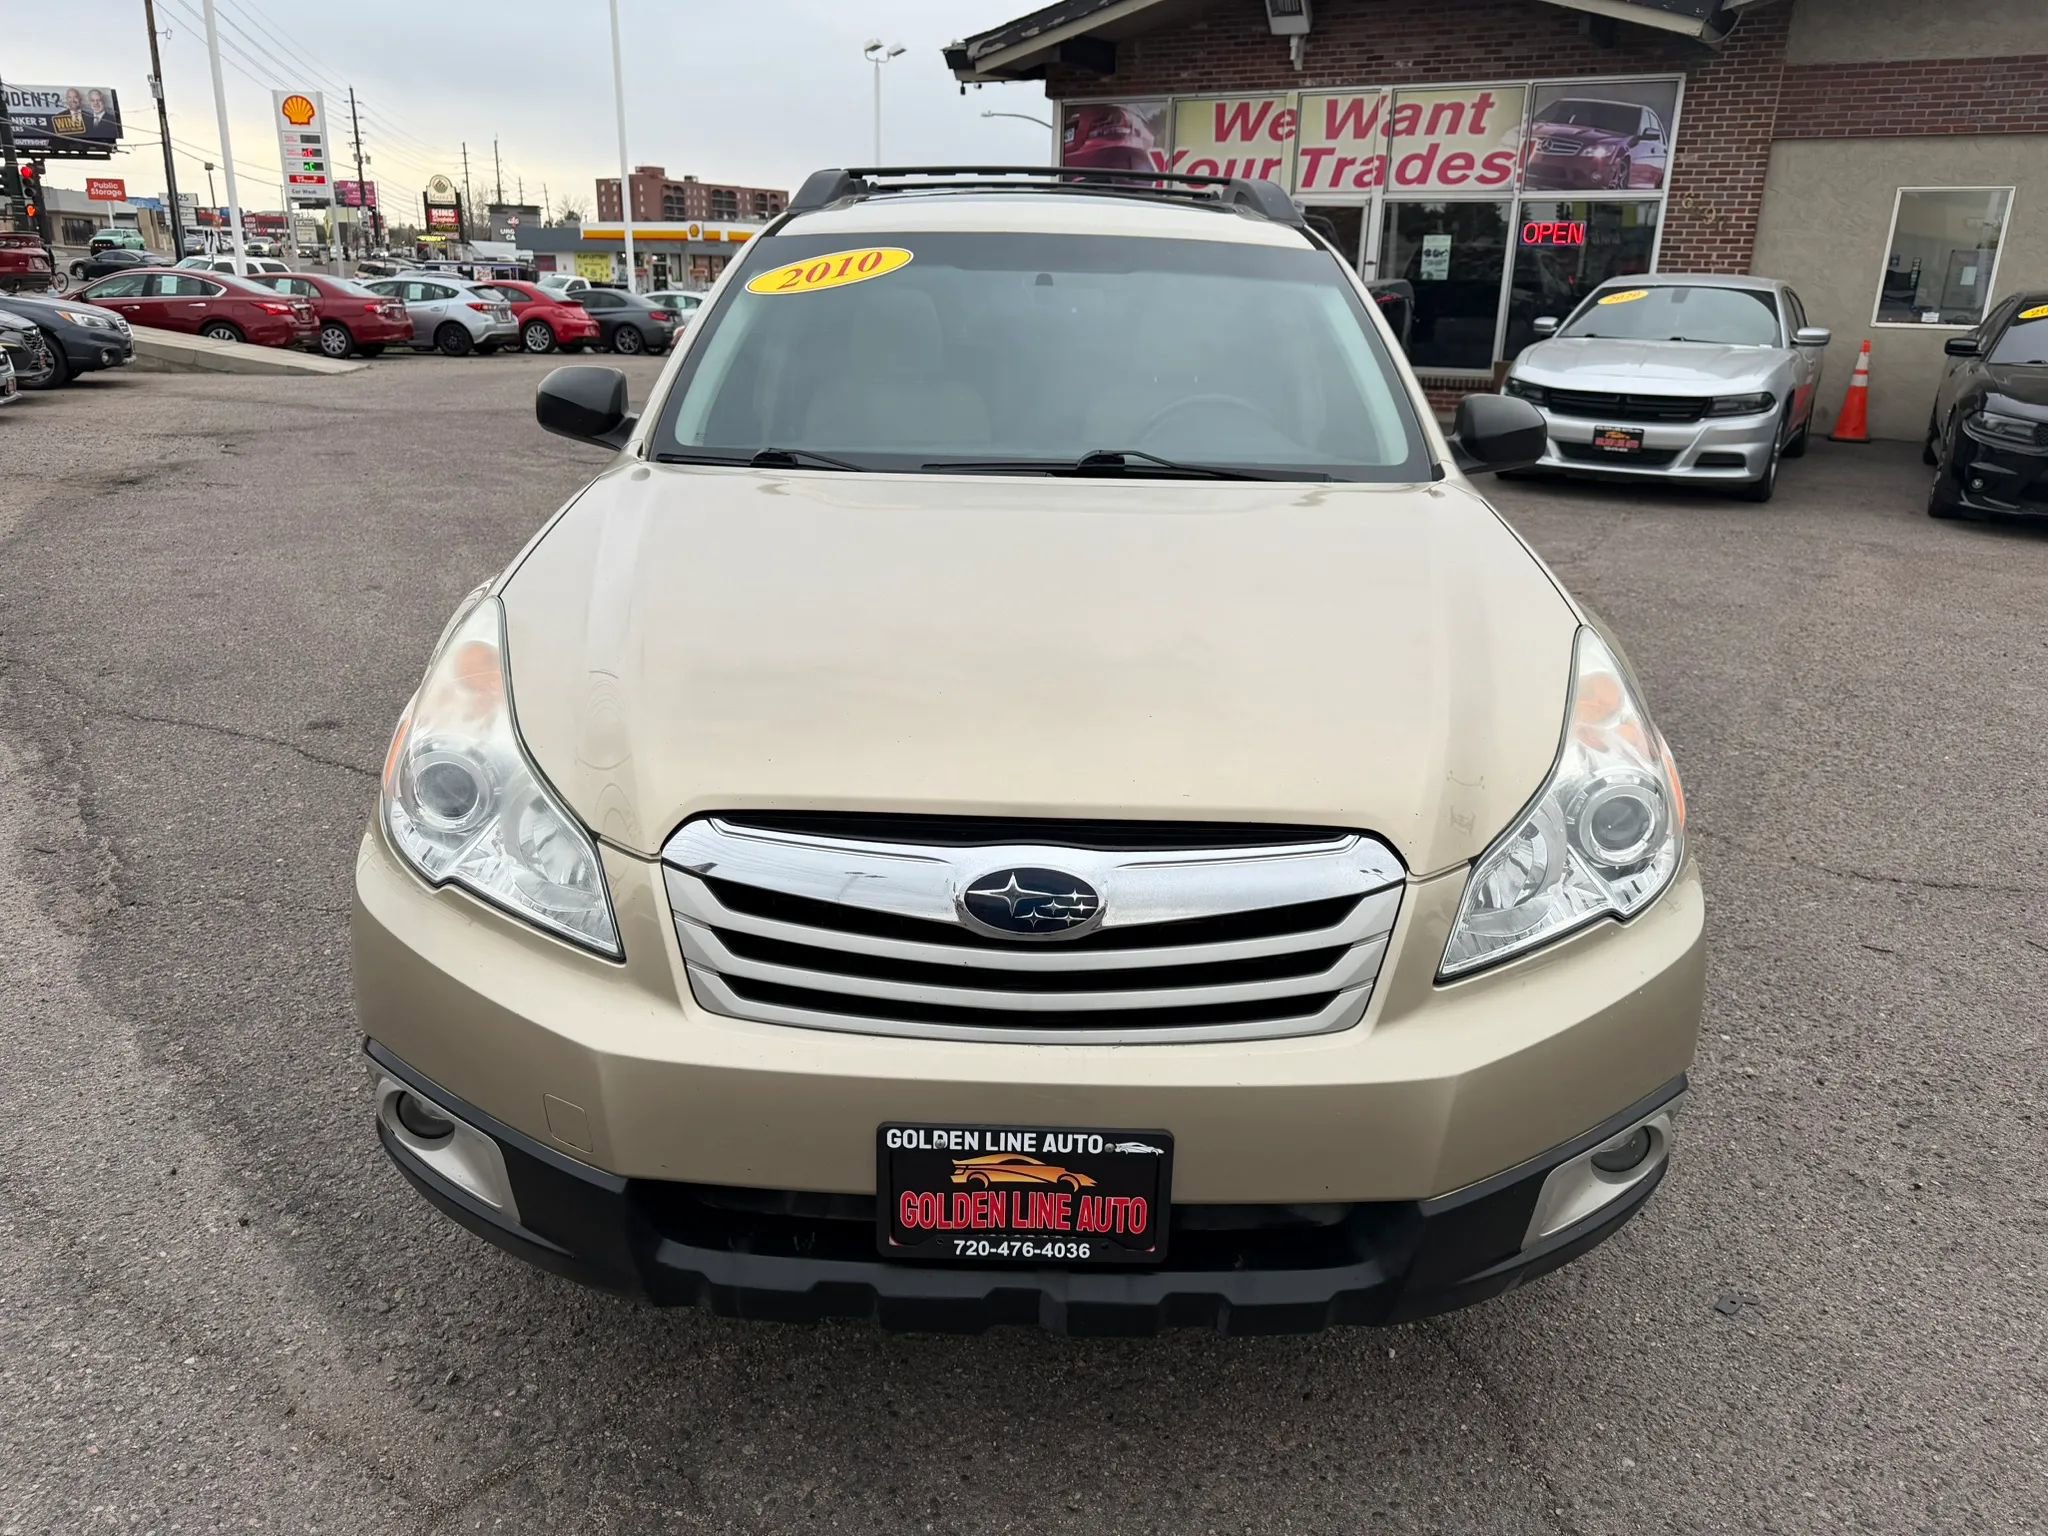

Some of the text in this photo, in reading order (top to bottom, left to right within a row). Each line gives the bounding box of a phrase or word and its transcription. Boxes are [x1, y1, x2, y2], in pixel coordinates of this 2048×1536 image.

[1214, 92, 1495, 143] We Want
[1150, 140, 1537, 190] Your Trades!
[90, 188, 122, 197] Storage
[93, 181, 119, 190] Public
[1522, 222, 1584, 244] OPEN
[776, 251, 883, 290] 2010
[886, 1129, 1104, 1154] GOLDEN LINE AUTO
[900, 1190, 1148, 1234] GOLDEN LINE AUTO
[953, 1240, 1091, 1258] 720-476-4036
